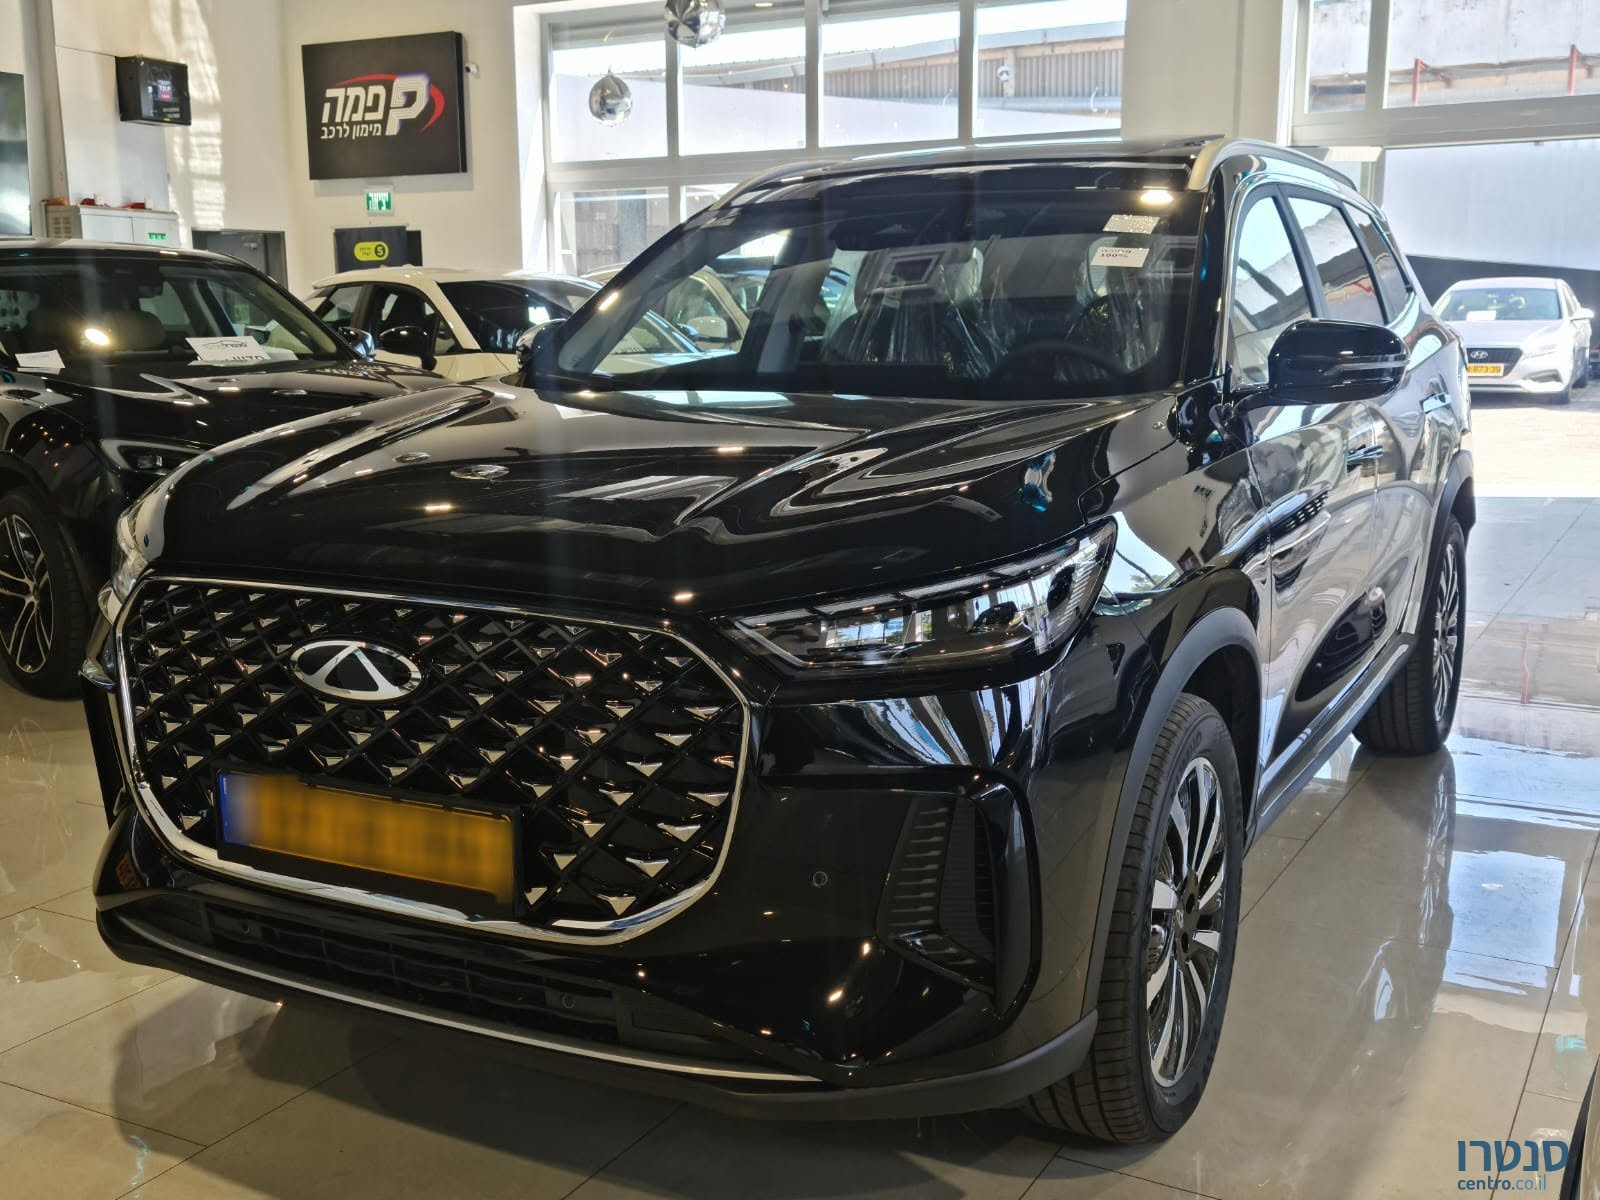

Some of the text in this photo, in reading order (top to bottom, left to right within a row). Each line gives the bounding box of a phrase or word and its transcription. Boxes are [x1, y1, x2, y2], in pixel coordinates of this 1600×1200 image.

[321, 85, 386, 123] פמה
[320, 123, 382, 140] מימון לרכב
